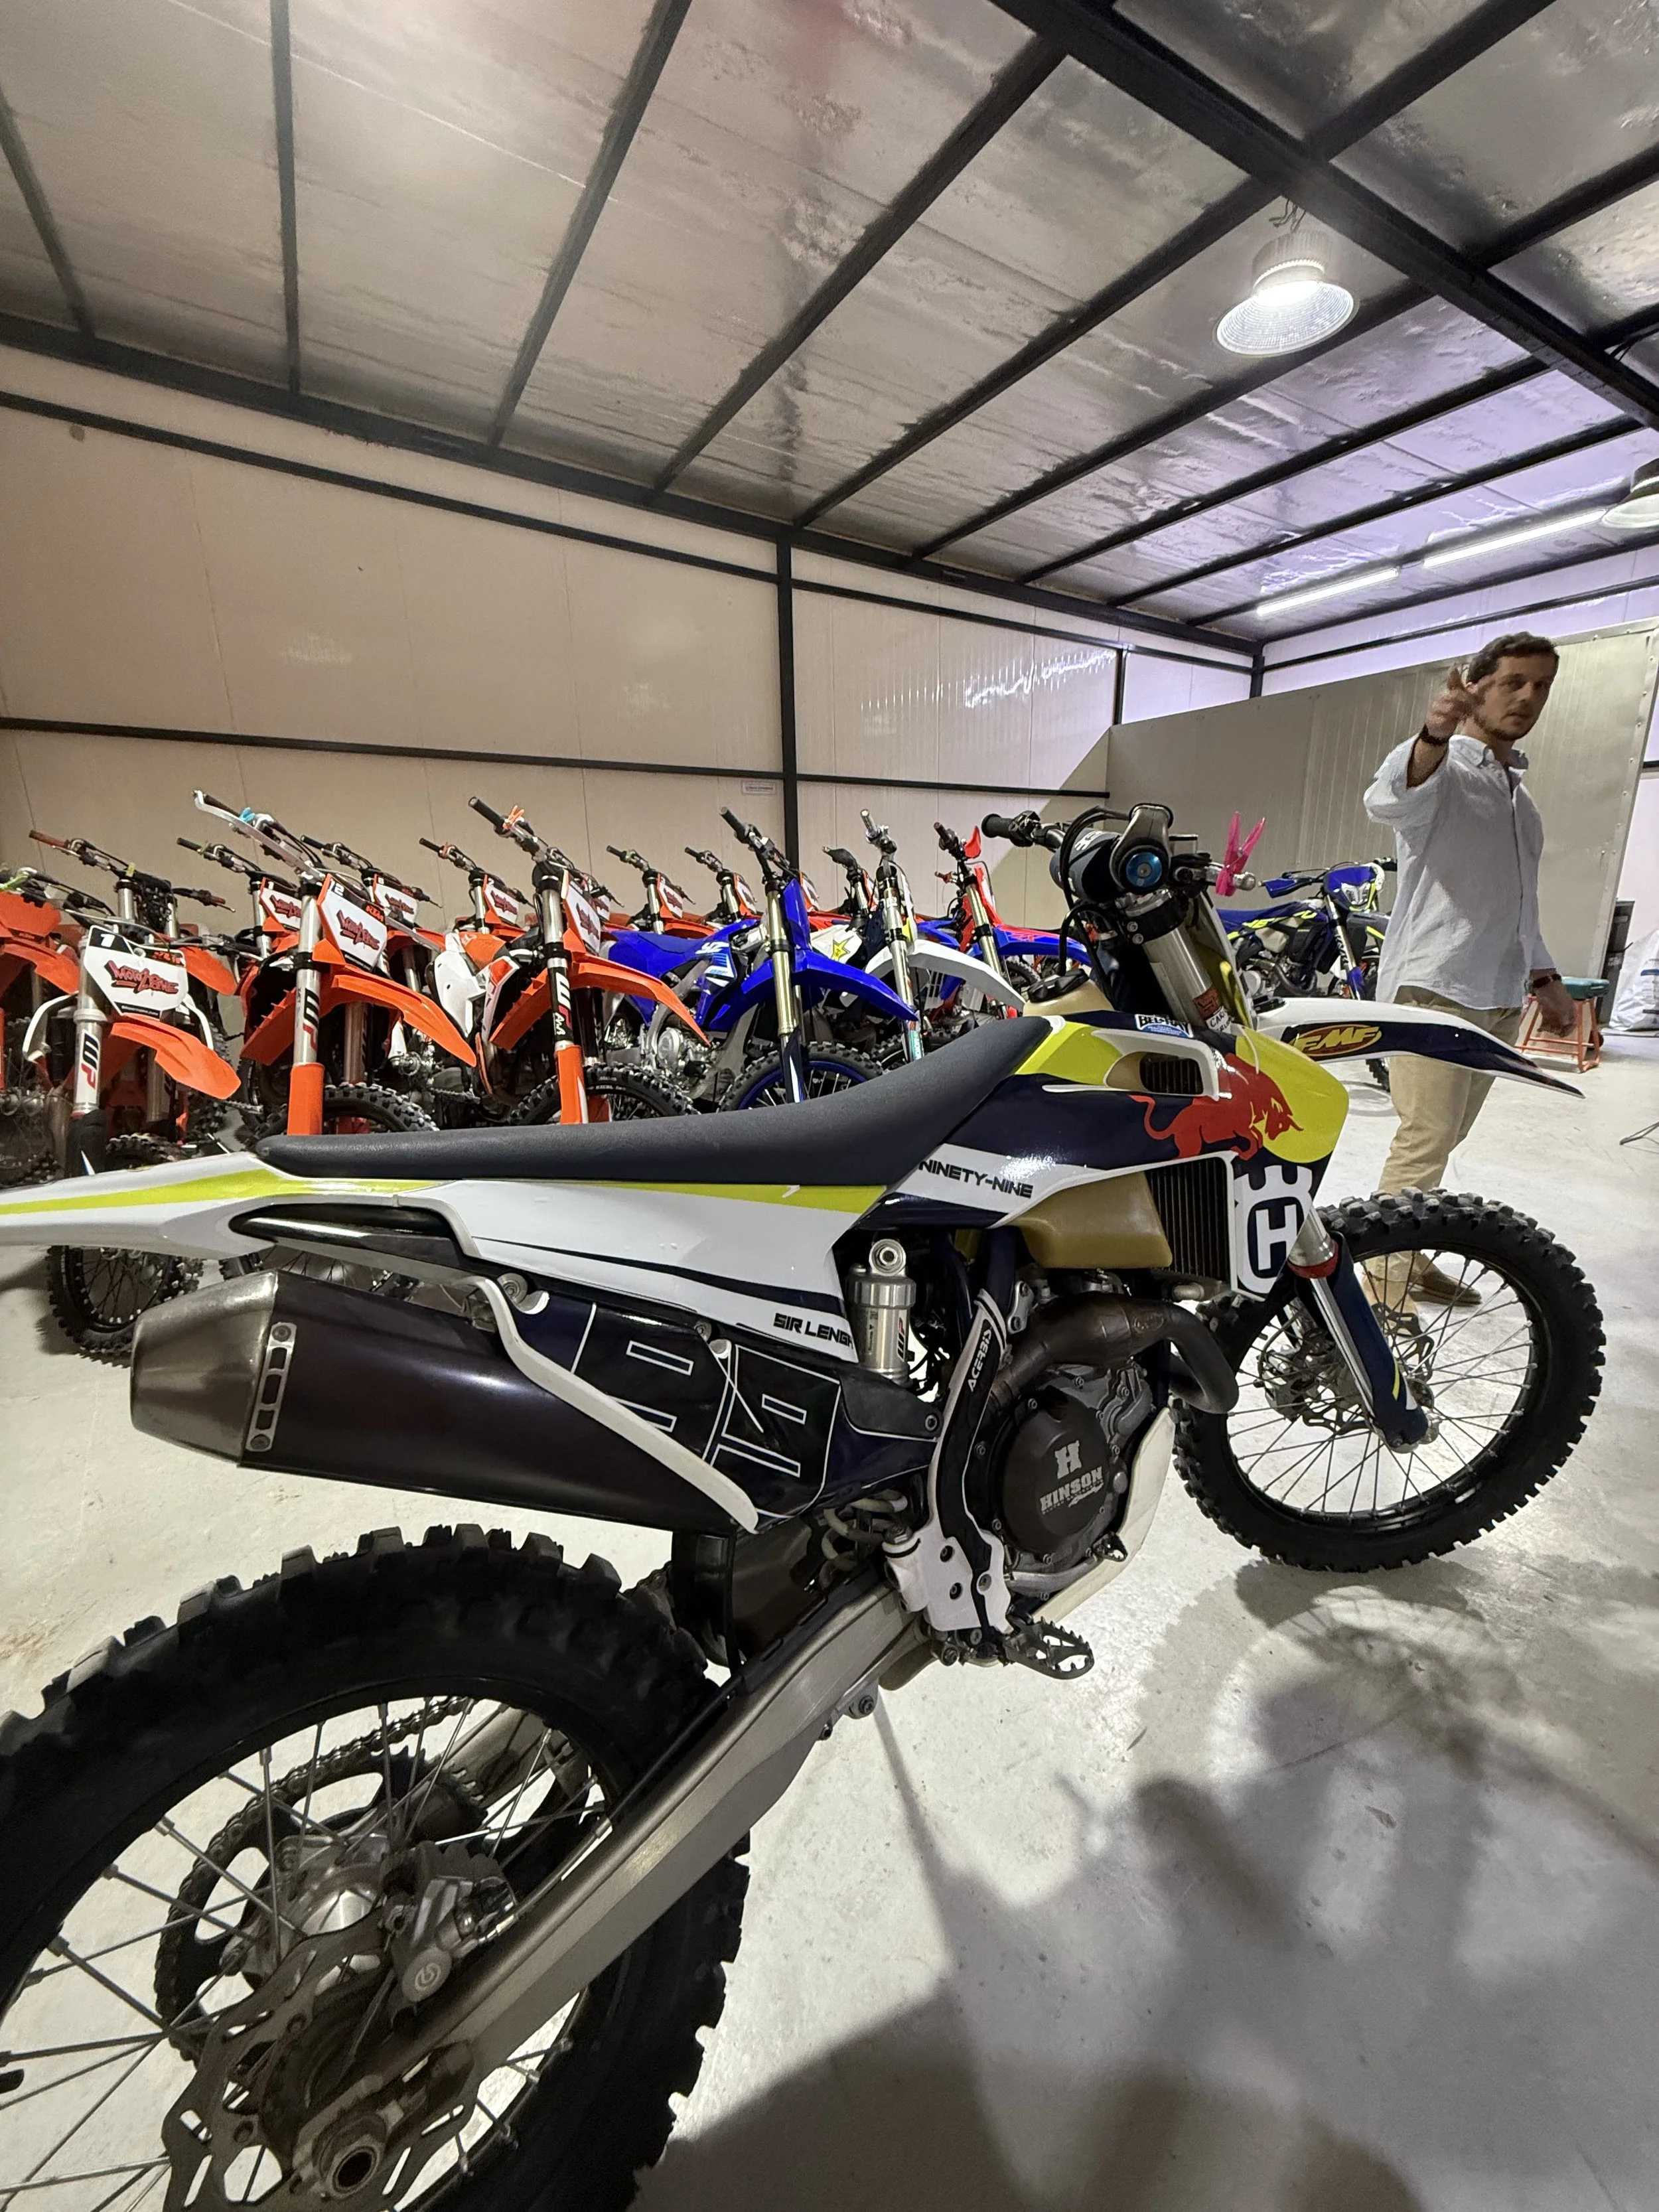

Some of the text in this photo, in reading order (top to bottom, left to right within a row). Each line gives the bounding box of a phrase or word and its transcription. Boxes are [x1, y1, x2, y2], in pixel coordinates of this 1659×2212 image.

[100, 933, 115, 948] 1
[1294, 1026, 1380, 1051] FMF
[918, 1159, 1034, 1199] NINETY-NINE
[773, 1313, 804, 1334] SIR
[1054, 1439, 1082, 1479] H
[1039, 1465, 1103, 1512] HINSON
